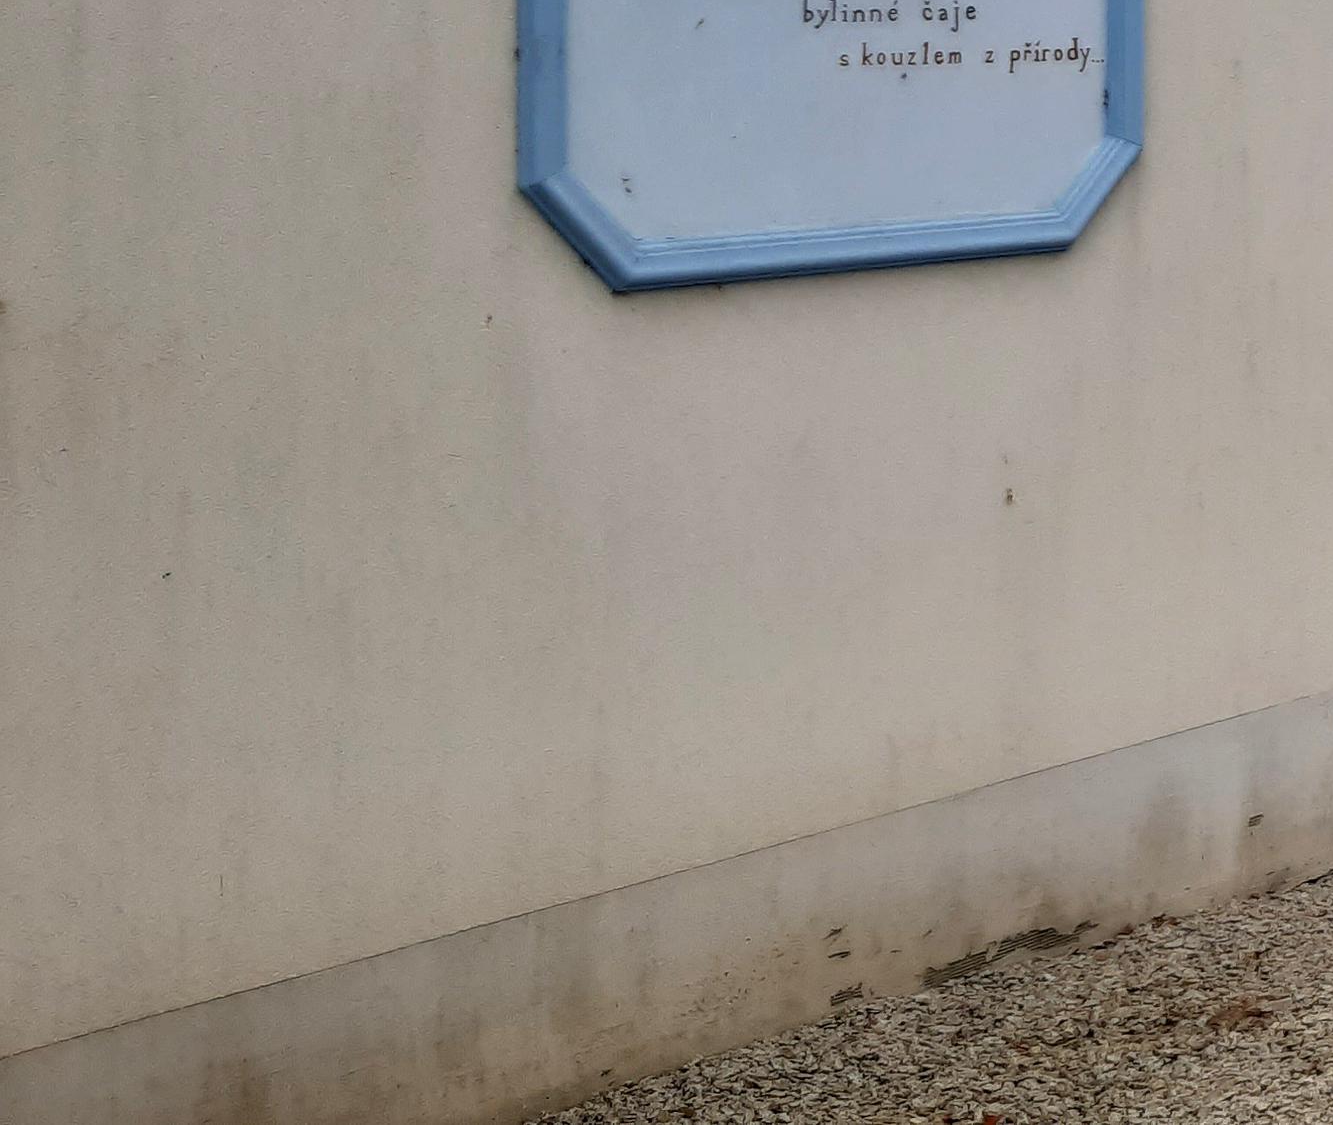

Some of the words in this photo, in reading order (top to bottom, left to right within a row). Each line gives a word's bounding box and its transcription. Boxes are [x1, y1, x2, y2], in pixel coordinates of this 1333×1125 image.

[922, 0, 978, 33] čaje
[838, 53, 850, 67] s
[861, 41, 963, 66] kouzlem
[984, 50, 995, 64] z
